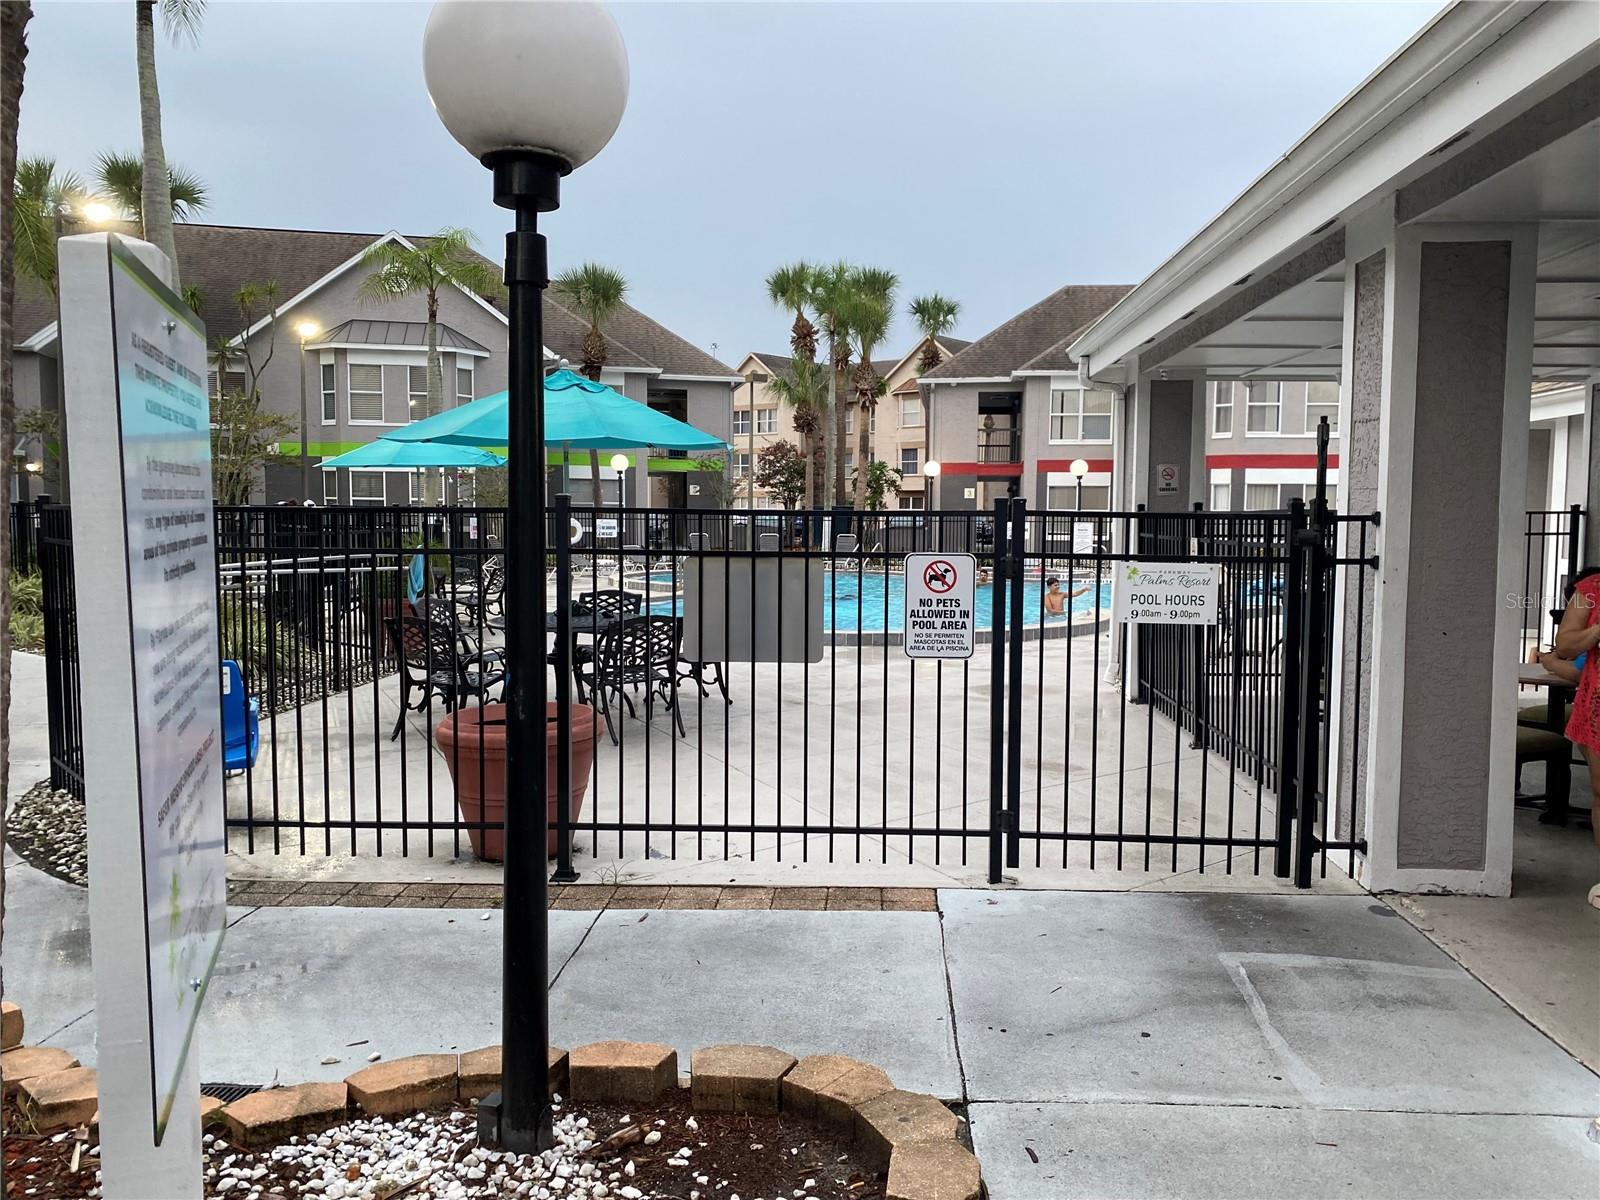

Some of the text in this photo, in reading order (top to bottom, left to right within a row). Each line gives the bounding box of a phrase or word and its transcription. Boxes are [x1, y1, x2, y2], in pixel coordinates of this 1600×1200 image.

[1139, 573, 1212, 589] Palms Resort
[919, 598, 961, 608] NO PETS
[1130, 593, 1206, 607] POOL HOURS
[909, 609, 970, 619] ALLOWED IN
[912, 620, 967, 630] POOL AREA
